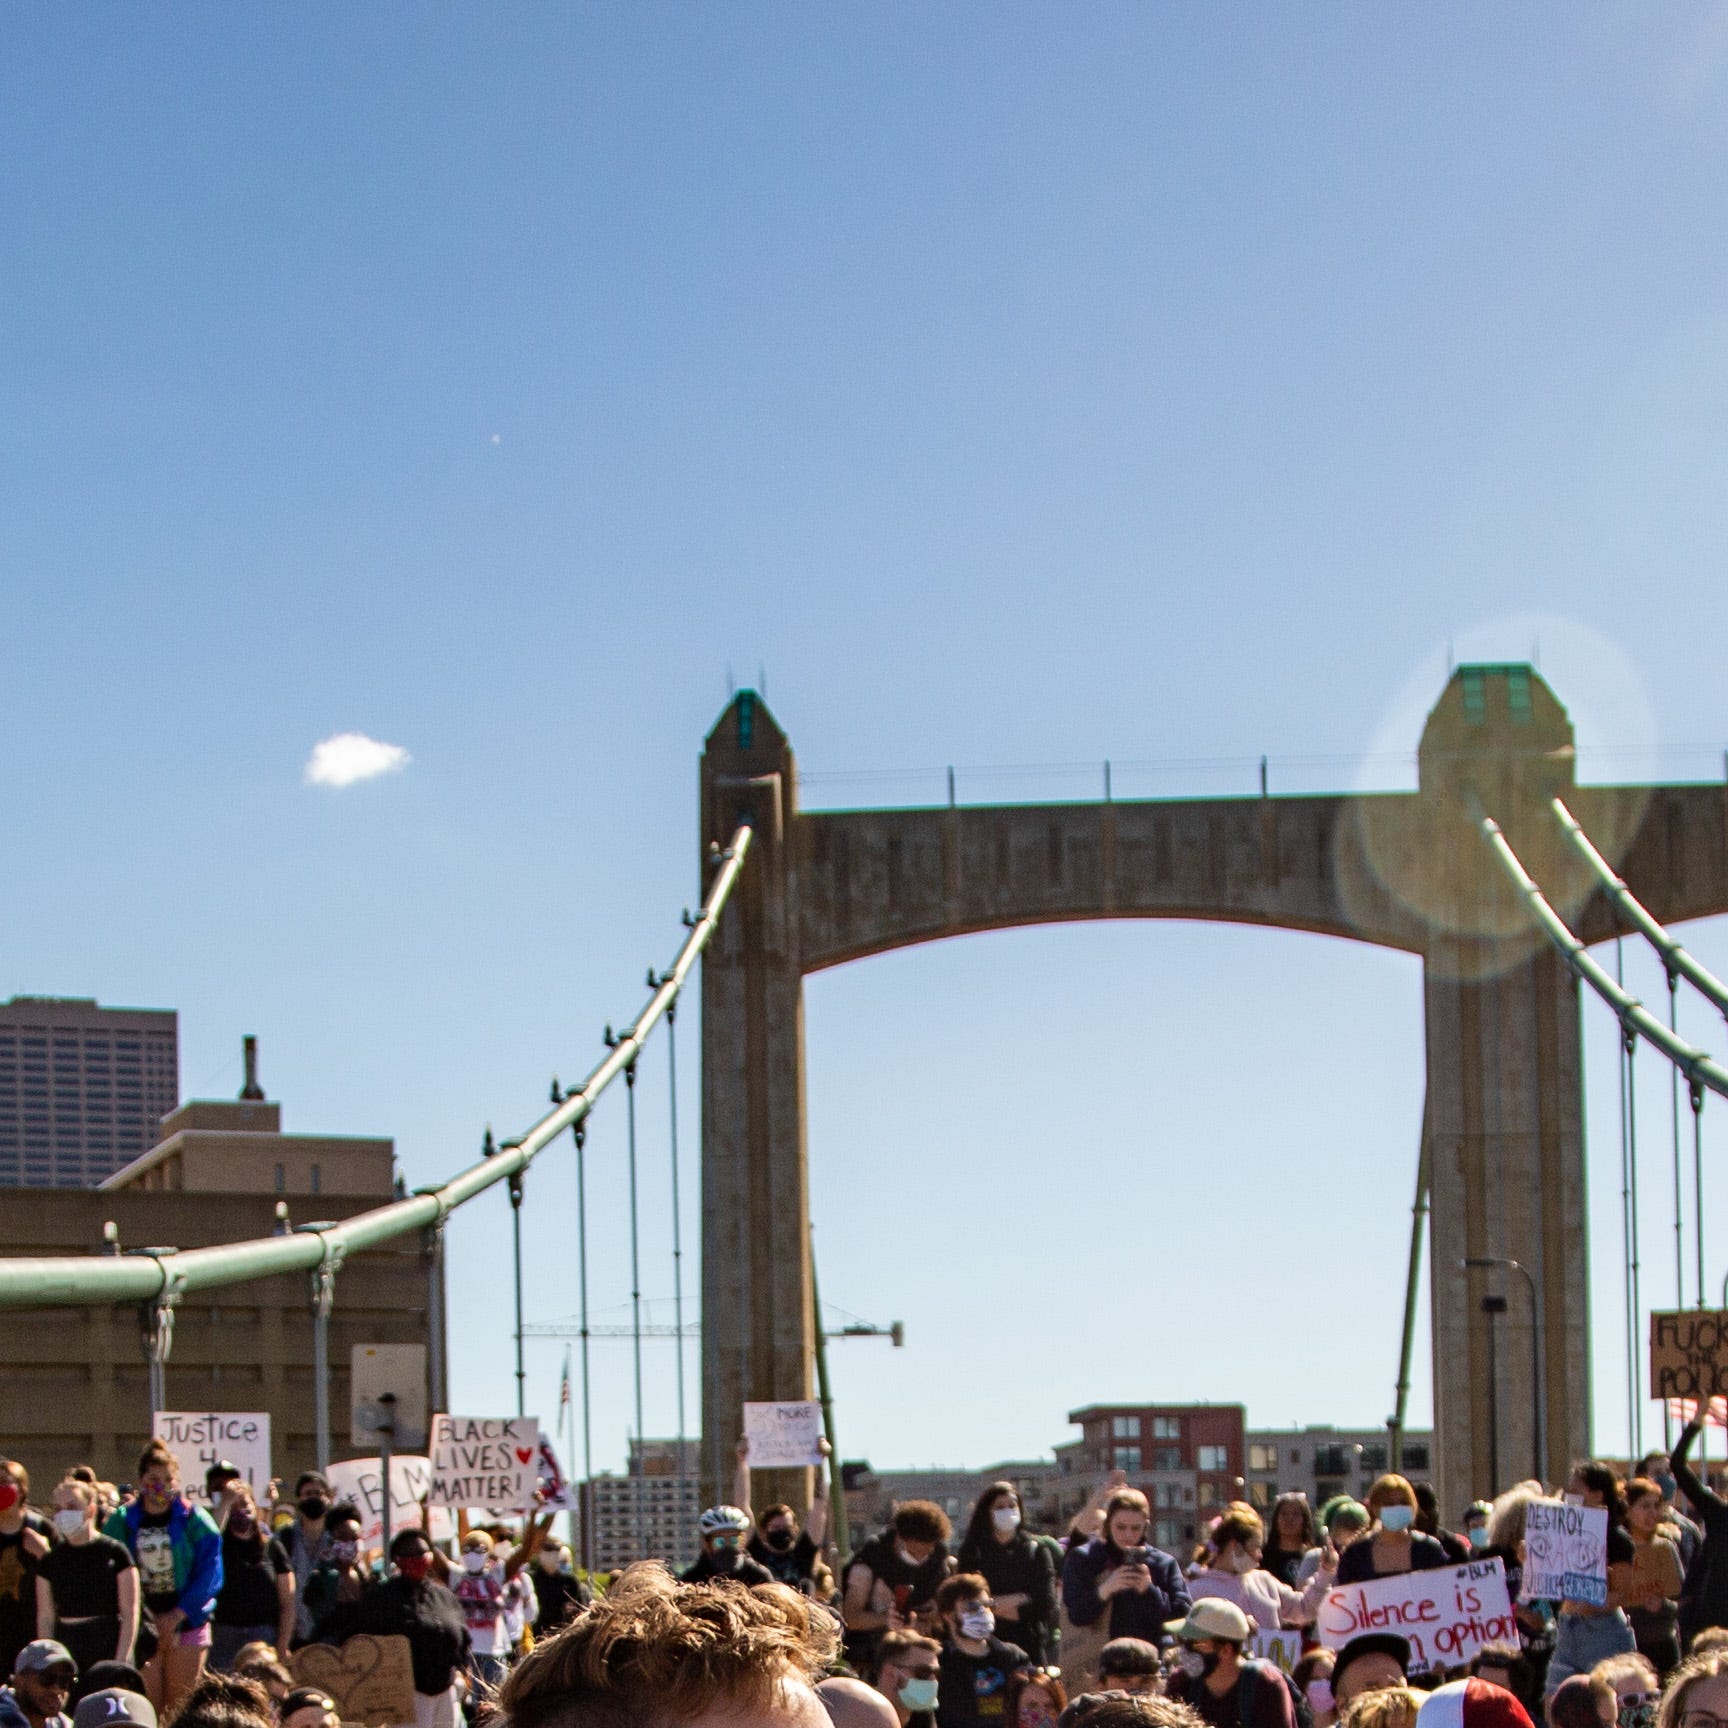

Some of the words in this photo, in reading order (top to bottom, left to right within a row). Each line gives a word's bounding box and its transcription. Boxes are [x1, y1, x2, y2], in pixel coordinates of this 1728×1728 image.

[438, 1418, 522, 1443] BLACK
[435, 1442, 513, 1471] LIVES
[430, 1473, 521, 1502] MATTER!
[1527, 1503, 1585, 1537] DESTROY
[1456, 1561, 1497, 1581] #BLM
[1326, 1589, 1440, 1635] Silence
[1454, 1584, 1482, 1613] is
[1434, 1613, 1518, 1658] option
